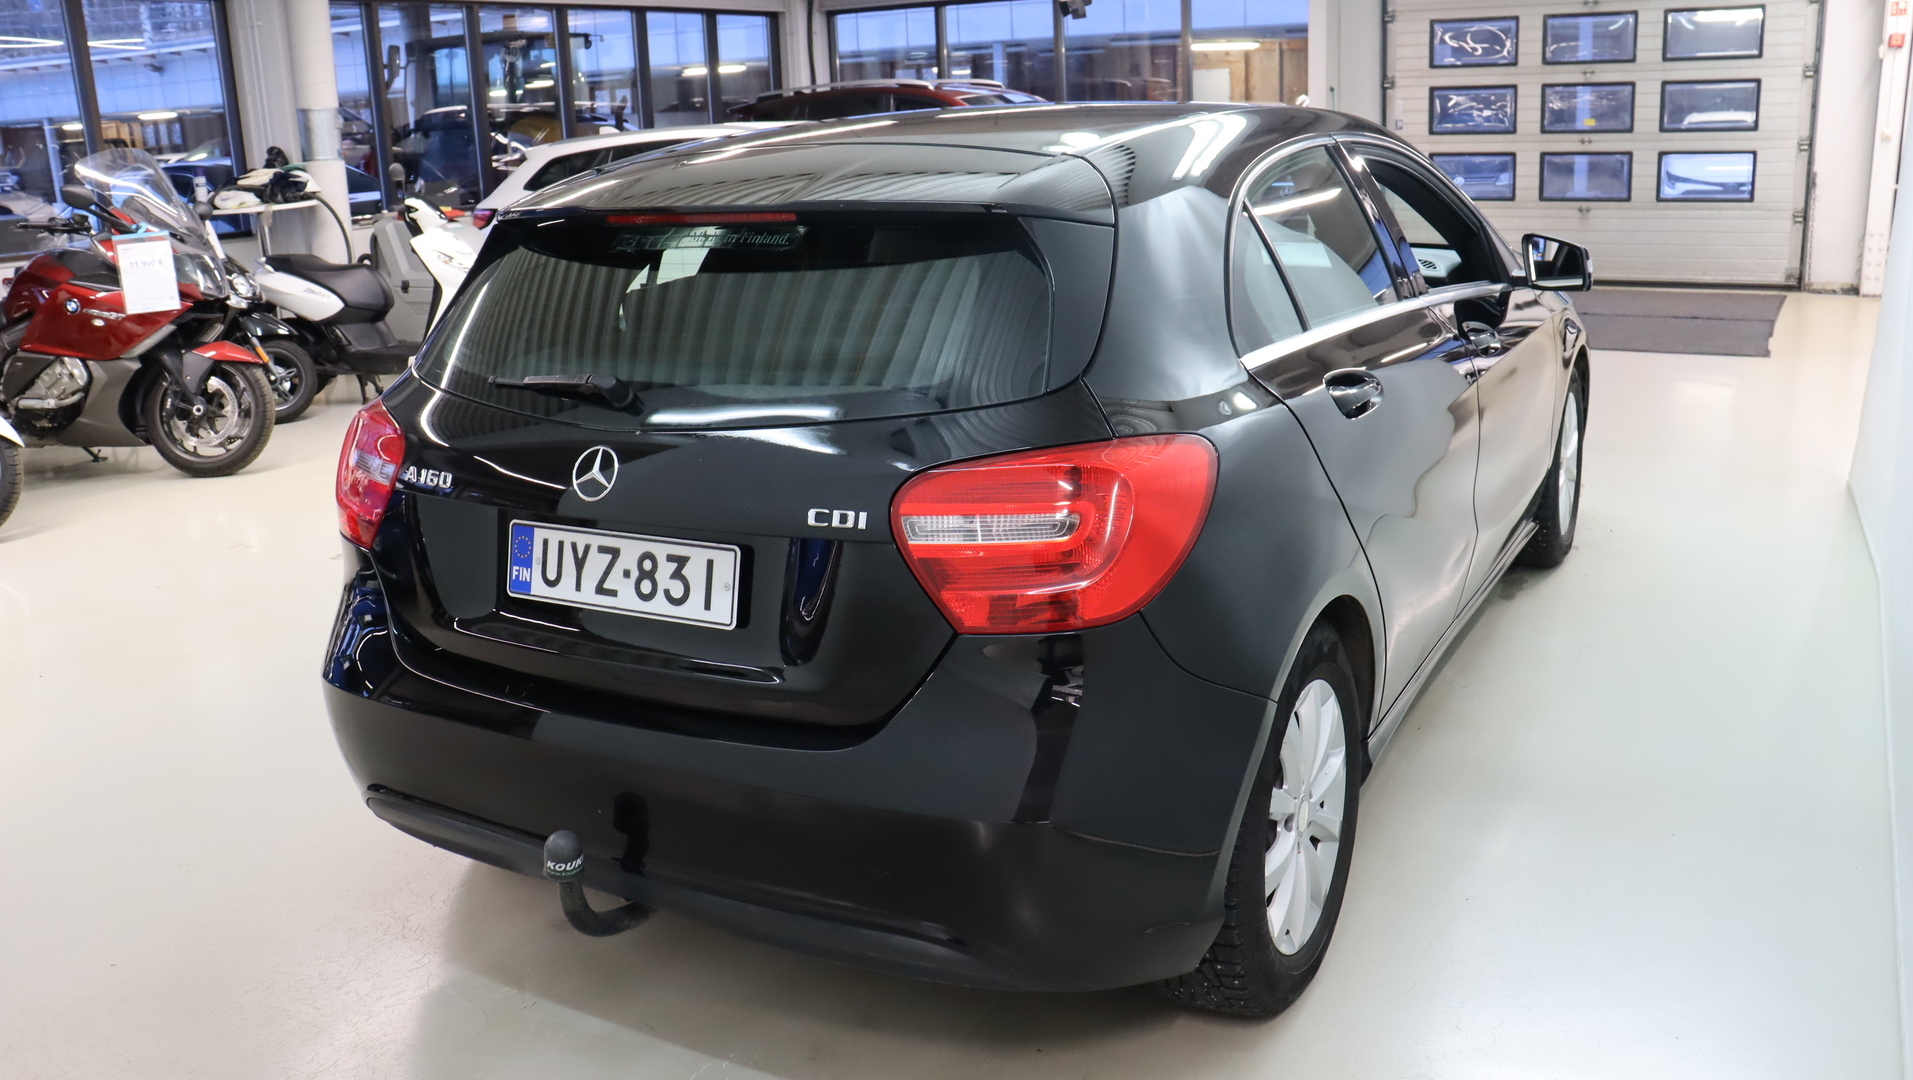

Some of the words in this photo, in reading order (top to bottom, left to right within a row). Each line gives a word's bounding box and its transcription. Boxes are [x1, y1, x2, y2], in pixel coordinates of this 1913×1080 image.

[723, 232, 738, 243] in
[739, 232, 789, 245] Finland.
[807, 508, 868, 530] CDI
[512, 565, 531, 582] FIN
